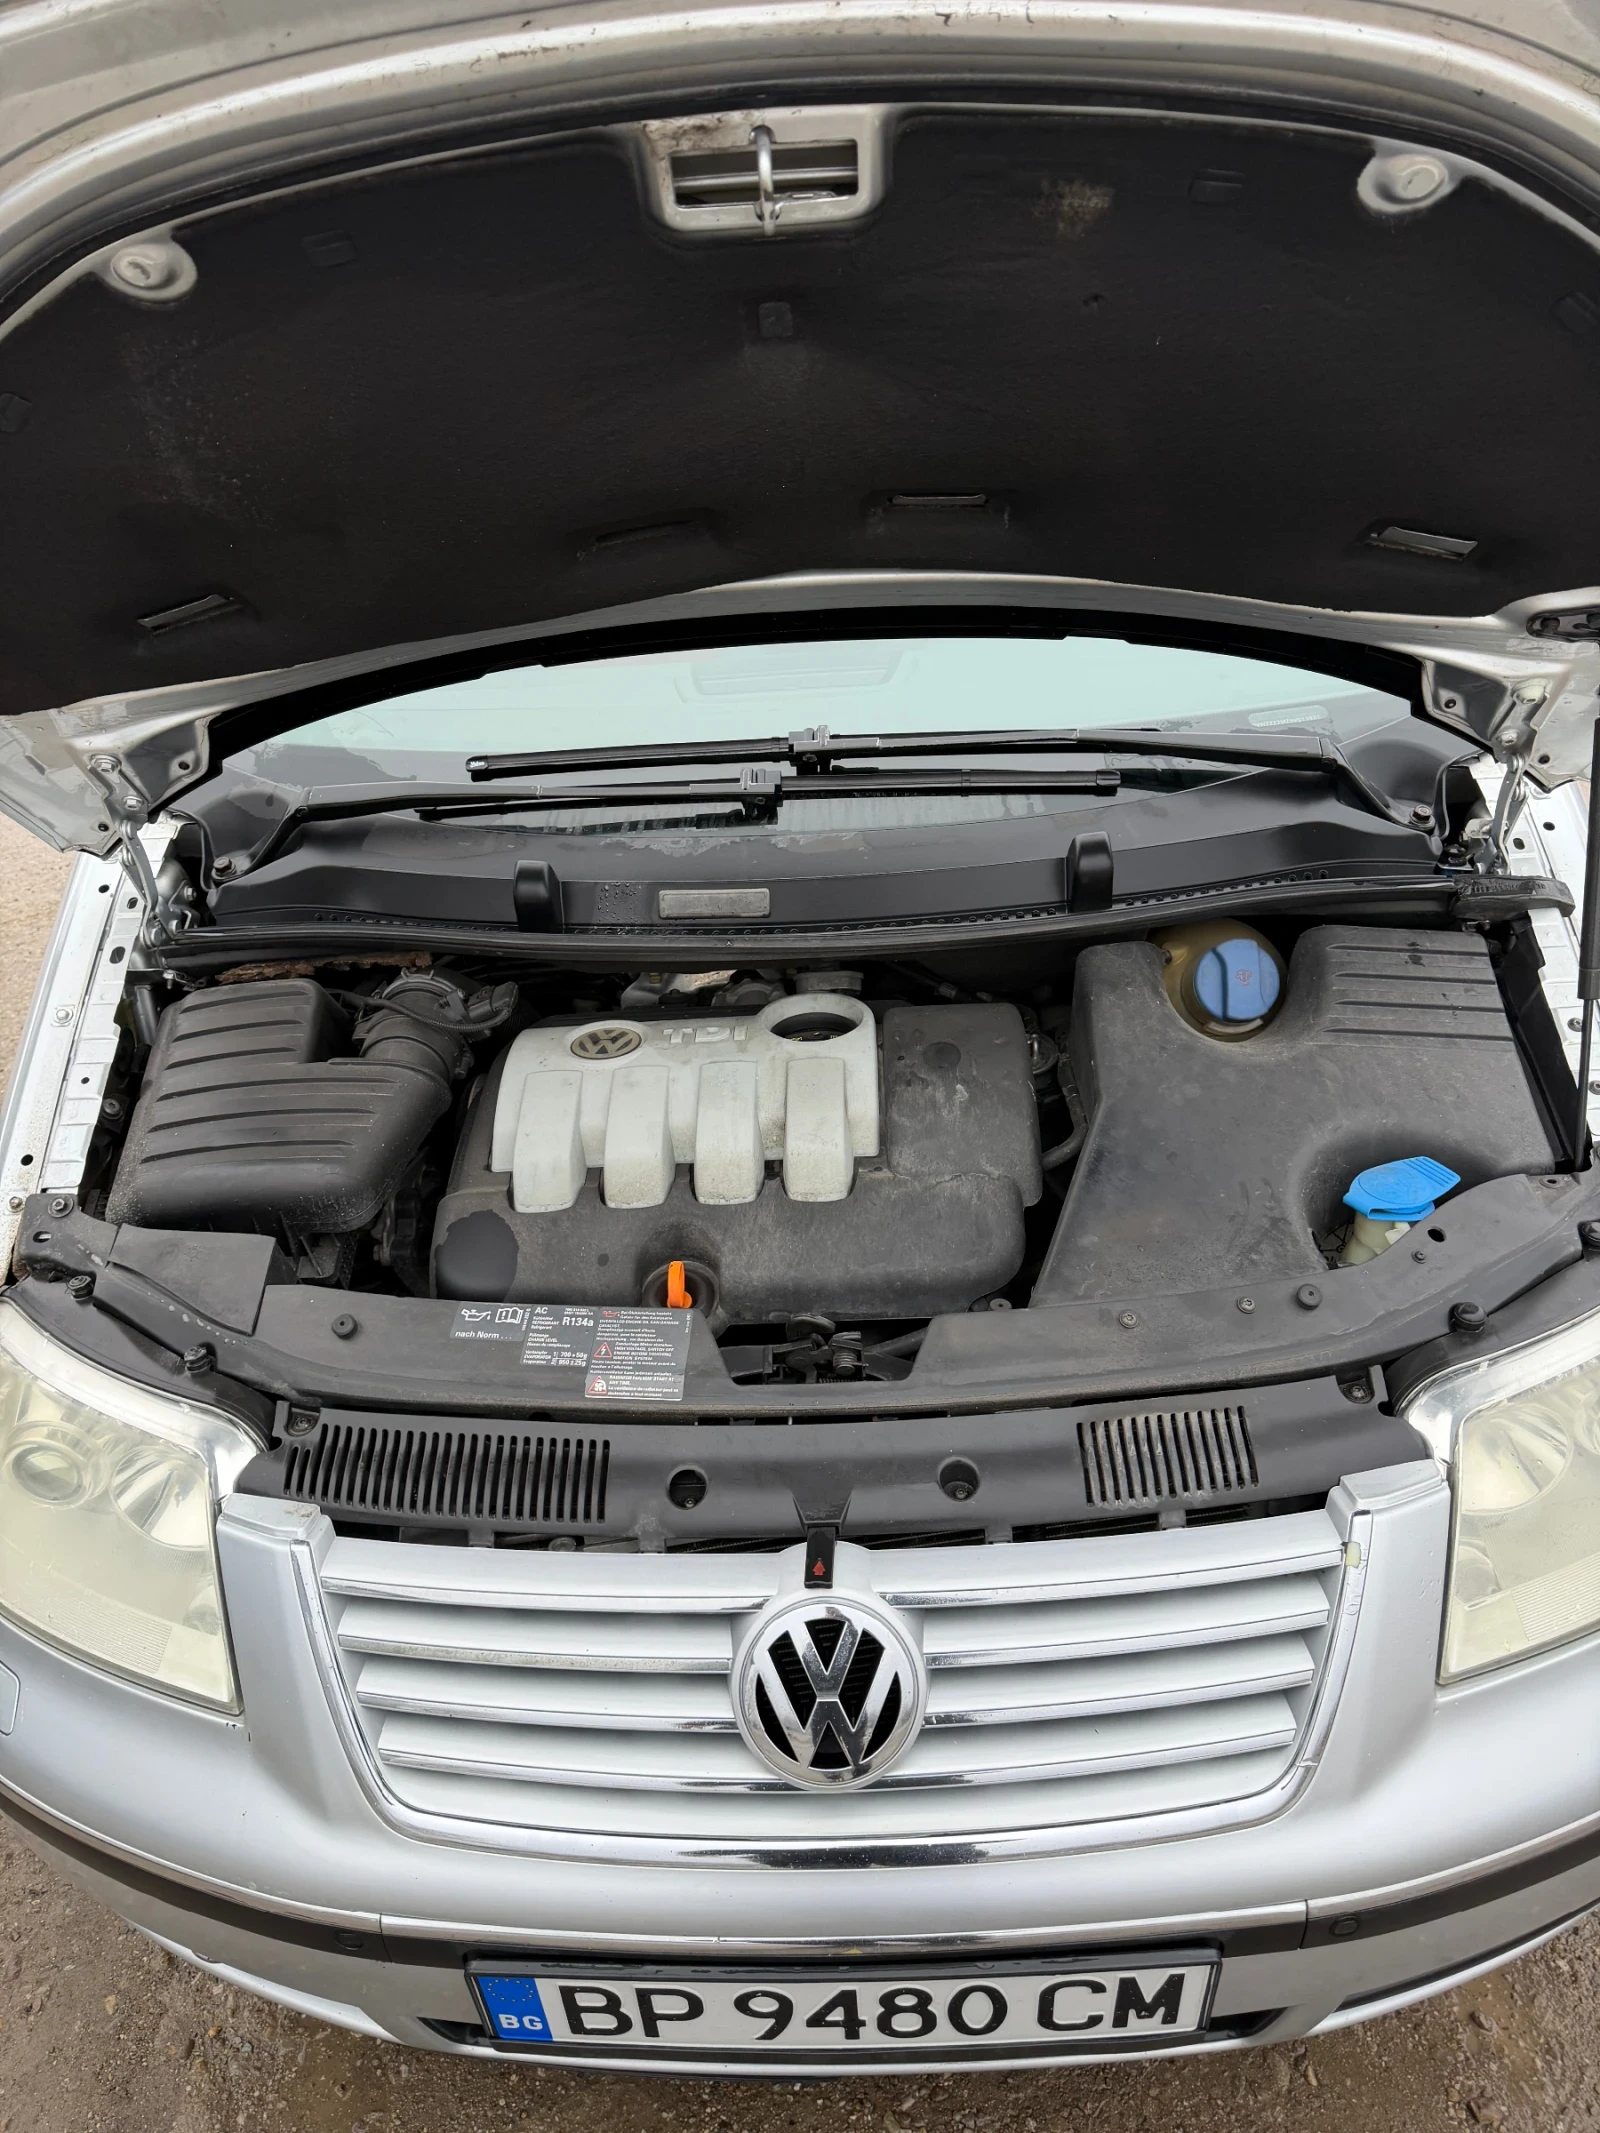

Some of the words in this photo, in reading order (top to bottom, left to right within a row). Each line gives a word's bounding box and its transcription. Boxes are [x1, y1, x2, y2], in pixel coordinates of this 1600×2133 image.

[663, 1025, 748, 1044] TDI
[535, 1306, 548, 1314] AC
[562, 1316, 594, 1327] R134a
[455, 1330, 476, 1338] nach
[557, 1984, 704, 2038] BP
[733, 1983, 1008, 2041] 9480
[1037, 1972, 1186, 2032] CM
[498, 2013, 543, 2031] BG
